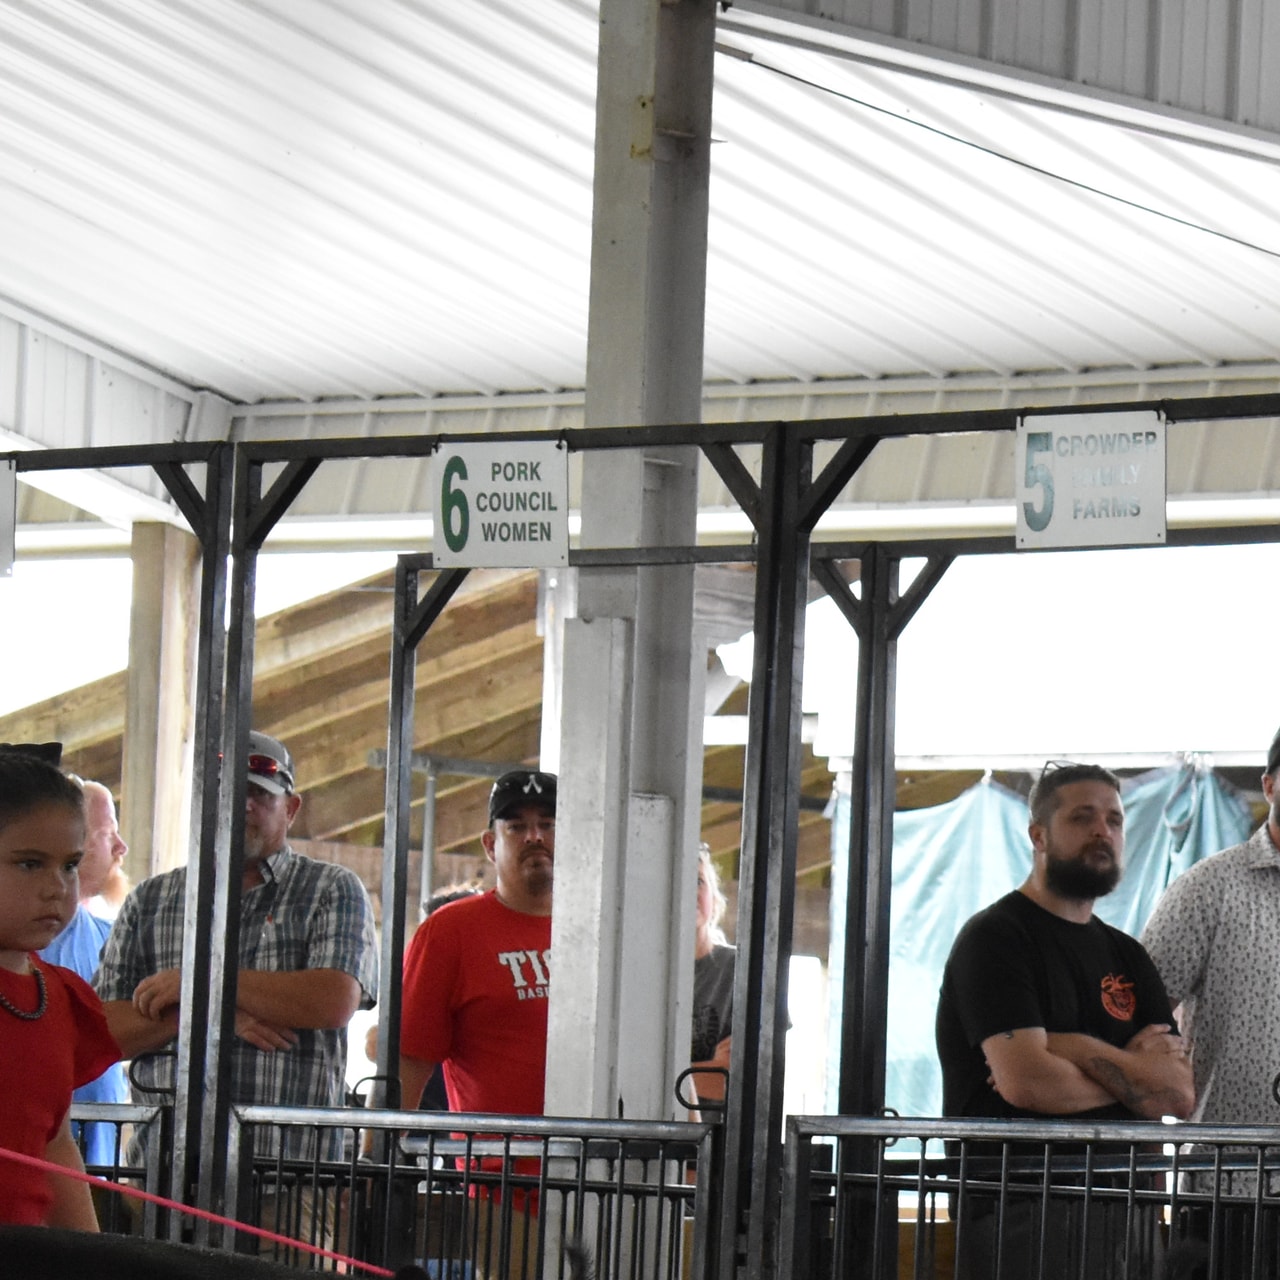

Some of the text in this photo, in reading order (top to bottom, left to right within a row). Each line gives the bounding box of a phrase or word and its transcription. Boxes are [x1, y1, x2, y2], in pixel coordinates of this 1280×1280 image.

[1056, 431, 1157, 457] CROWDER
[491, 461, 542, 481] PORK
[1023, 431, 1055, 532] 5
[441, 455, 470, 553] 6
[475, 491, 558, 513] COUNCIL
[1072, 496, 1141, 520] FARMS
[481, 521, 552, 541] WOMEN
